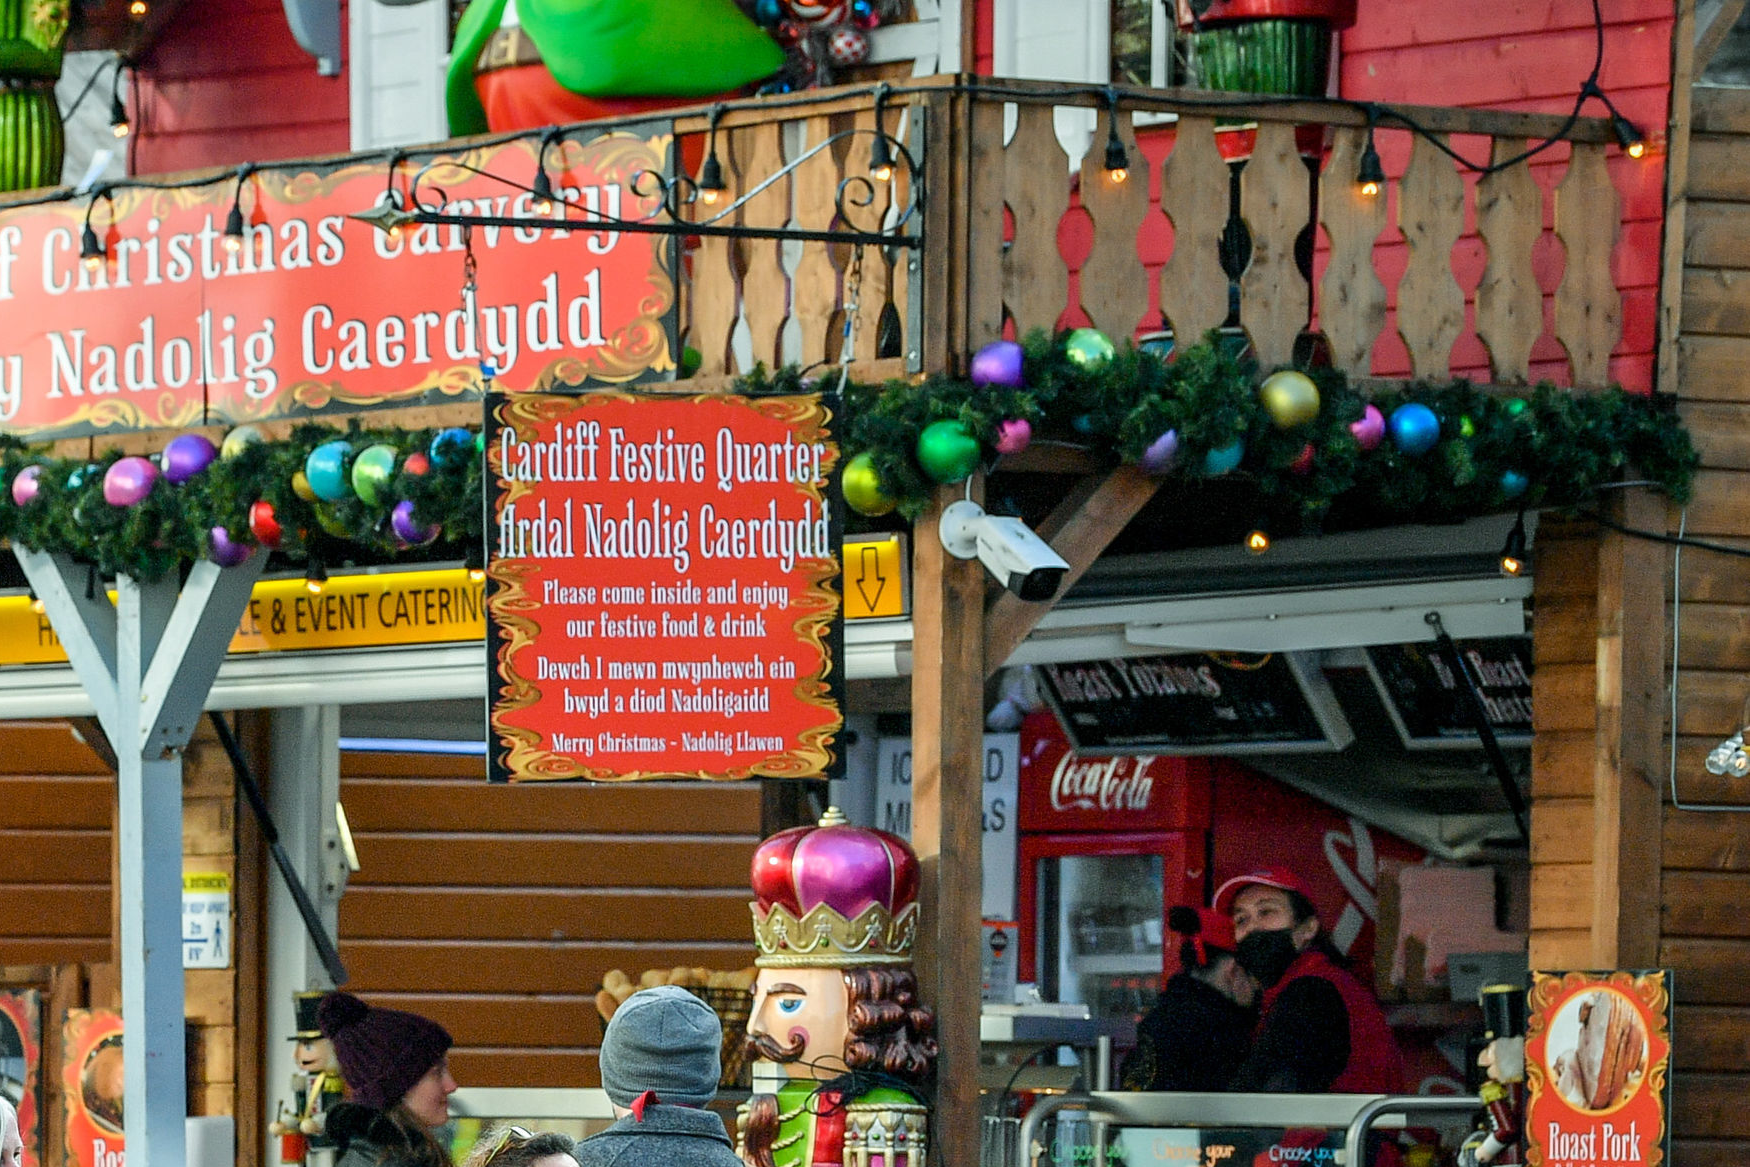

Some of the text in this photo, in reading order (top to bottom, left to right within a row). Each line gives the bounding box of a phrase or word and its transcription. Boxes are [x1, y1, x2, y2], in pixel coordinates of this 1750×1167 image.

[41, 210, 346, 297] Christmas
[373, 183, 622, 259] Carvery
[47, 310, 276, 399] Nadolig
[302, 267, 606, 376] Caerdydd
[501, 421, 826, 492] Cardiff Festive Quarter
[497, 498, 830, 574] Ardal Nadolig Caerdydd
[271, 598, 287, 634] &
[296, 593, 370, 633] EVENT
[543, 580, 789, 610] Please come inside and enjoy
[566, 612, 766, 638] our festive food & drink
[536, 655, 796, 685] Dewch I mewn mwynhewch ein
[564, 686, 771, 719] bwyd a diod Nadoligaidd
[551, 731, 784, 757] Merry Christmas Nadolig Llawen
[1269, 1144, 1312, 1162] Choose
[1548, 1120, 1641, 1161] Roast Pork
